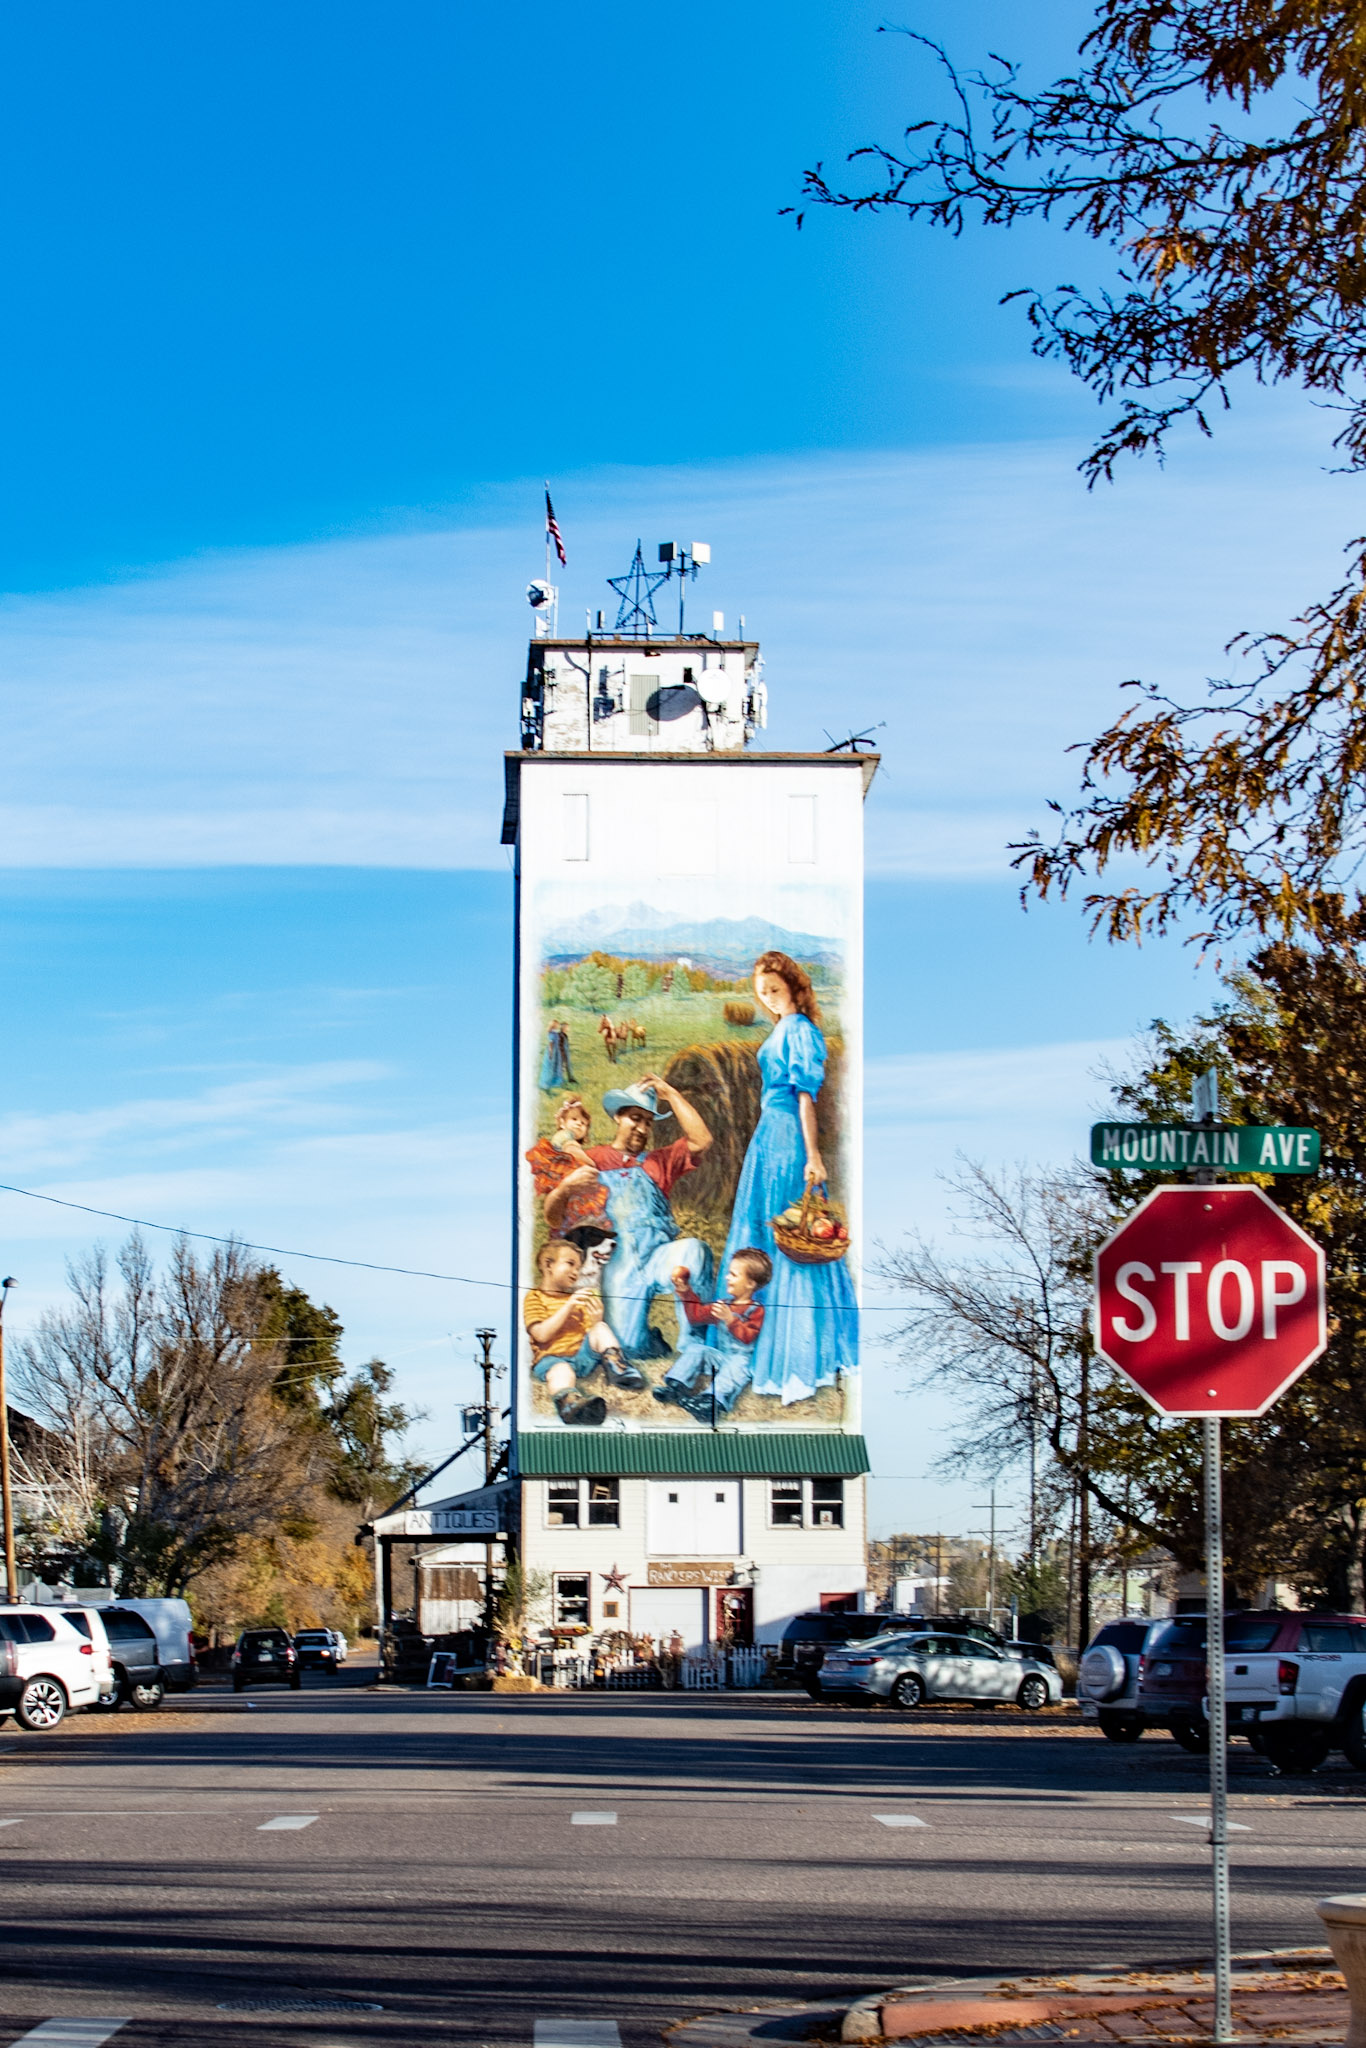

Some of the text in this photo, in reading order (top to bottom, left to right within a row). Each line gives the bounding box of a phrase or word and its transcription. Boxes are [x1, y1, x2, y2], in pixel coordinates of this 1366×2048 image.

[1102, 1127, 1312, 1167] MOUNTAIN AVE
[1111, 1259, 1306, 1343] STOP
[408, 1512, 496, 1529] ANTIQUES
